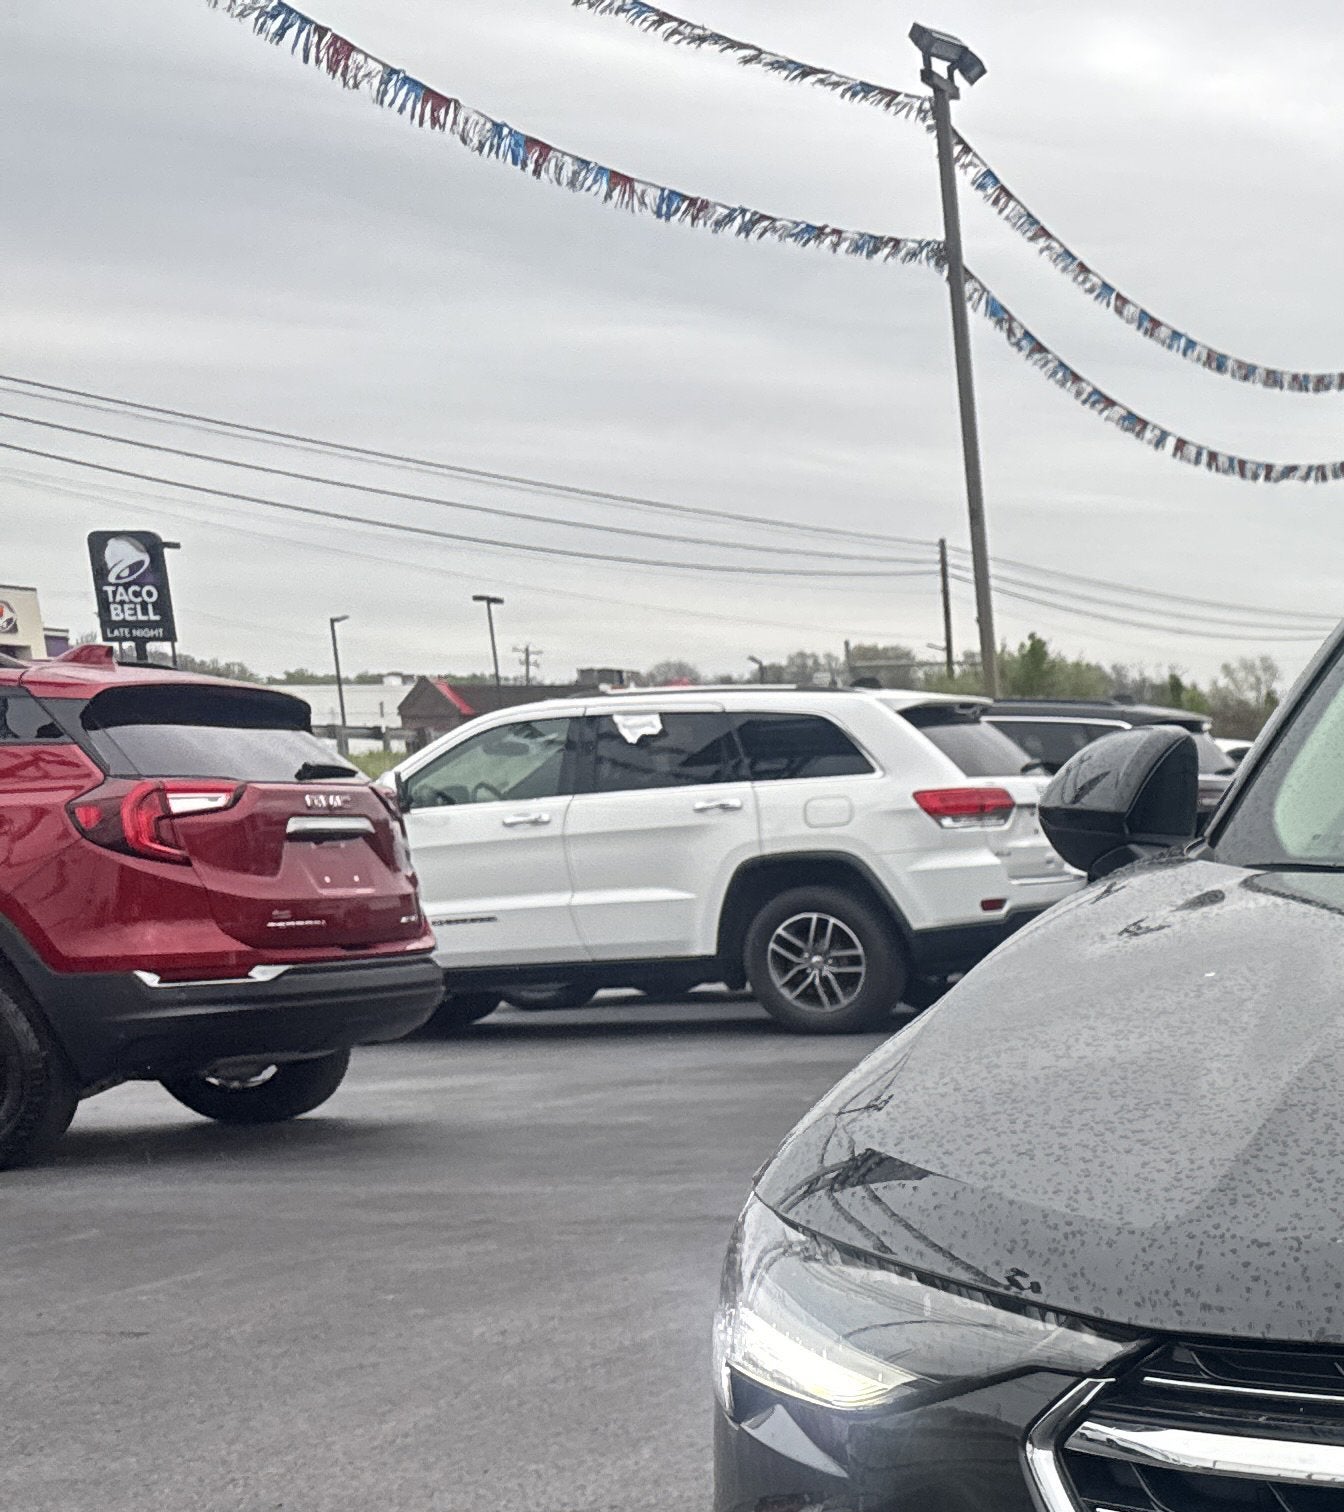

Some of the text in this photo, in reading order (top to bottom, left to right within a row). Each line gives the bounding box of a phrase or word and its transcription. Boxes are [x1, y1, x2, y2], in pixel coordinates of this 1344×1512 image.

[102, 585, 158, 603] TACO
[110, 603, 161, 621] BELL
[106, 627, 164, 638] LATE NIGHT
